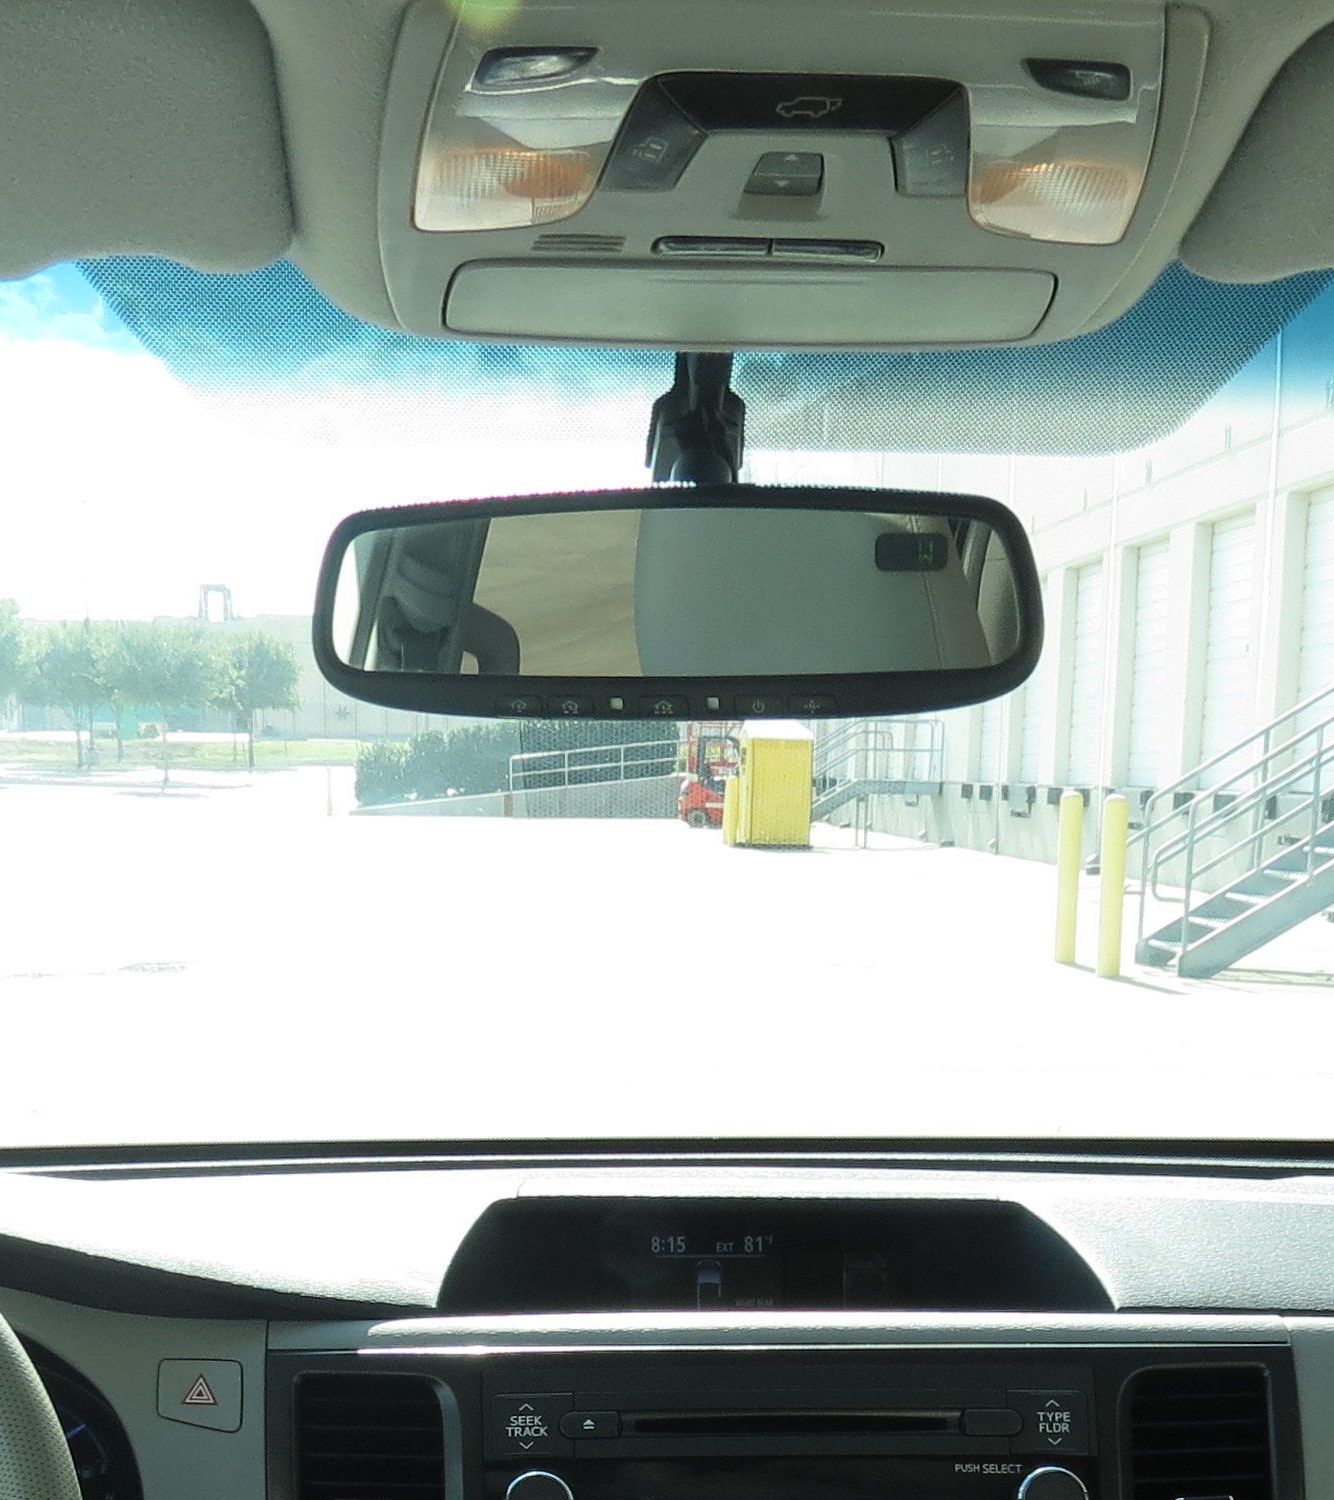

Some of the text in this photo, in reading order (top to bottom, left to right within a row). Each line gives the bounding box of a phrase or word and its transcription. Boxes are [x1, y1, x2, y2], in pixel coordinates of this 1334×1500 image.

[650, 1235, 686, 1254] 8:15
[716, 1241, 735, 1253] EXT
[509, 1415, 544, 1427] SEEK
[1036, 1411, 1071, 1424] TYPE
[505, 1426, 548, 1438] TRACK
[1038, 1422, 1071, 1434] FLDR
[954, 1462, 1023, 1475] PUSH SELECT
